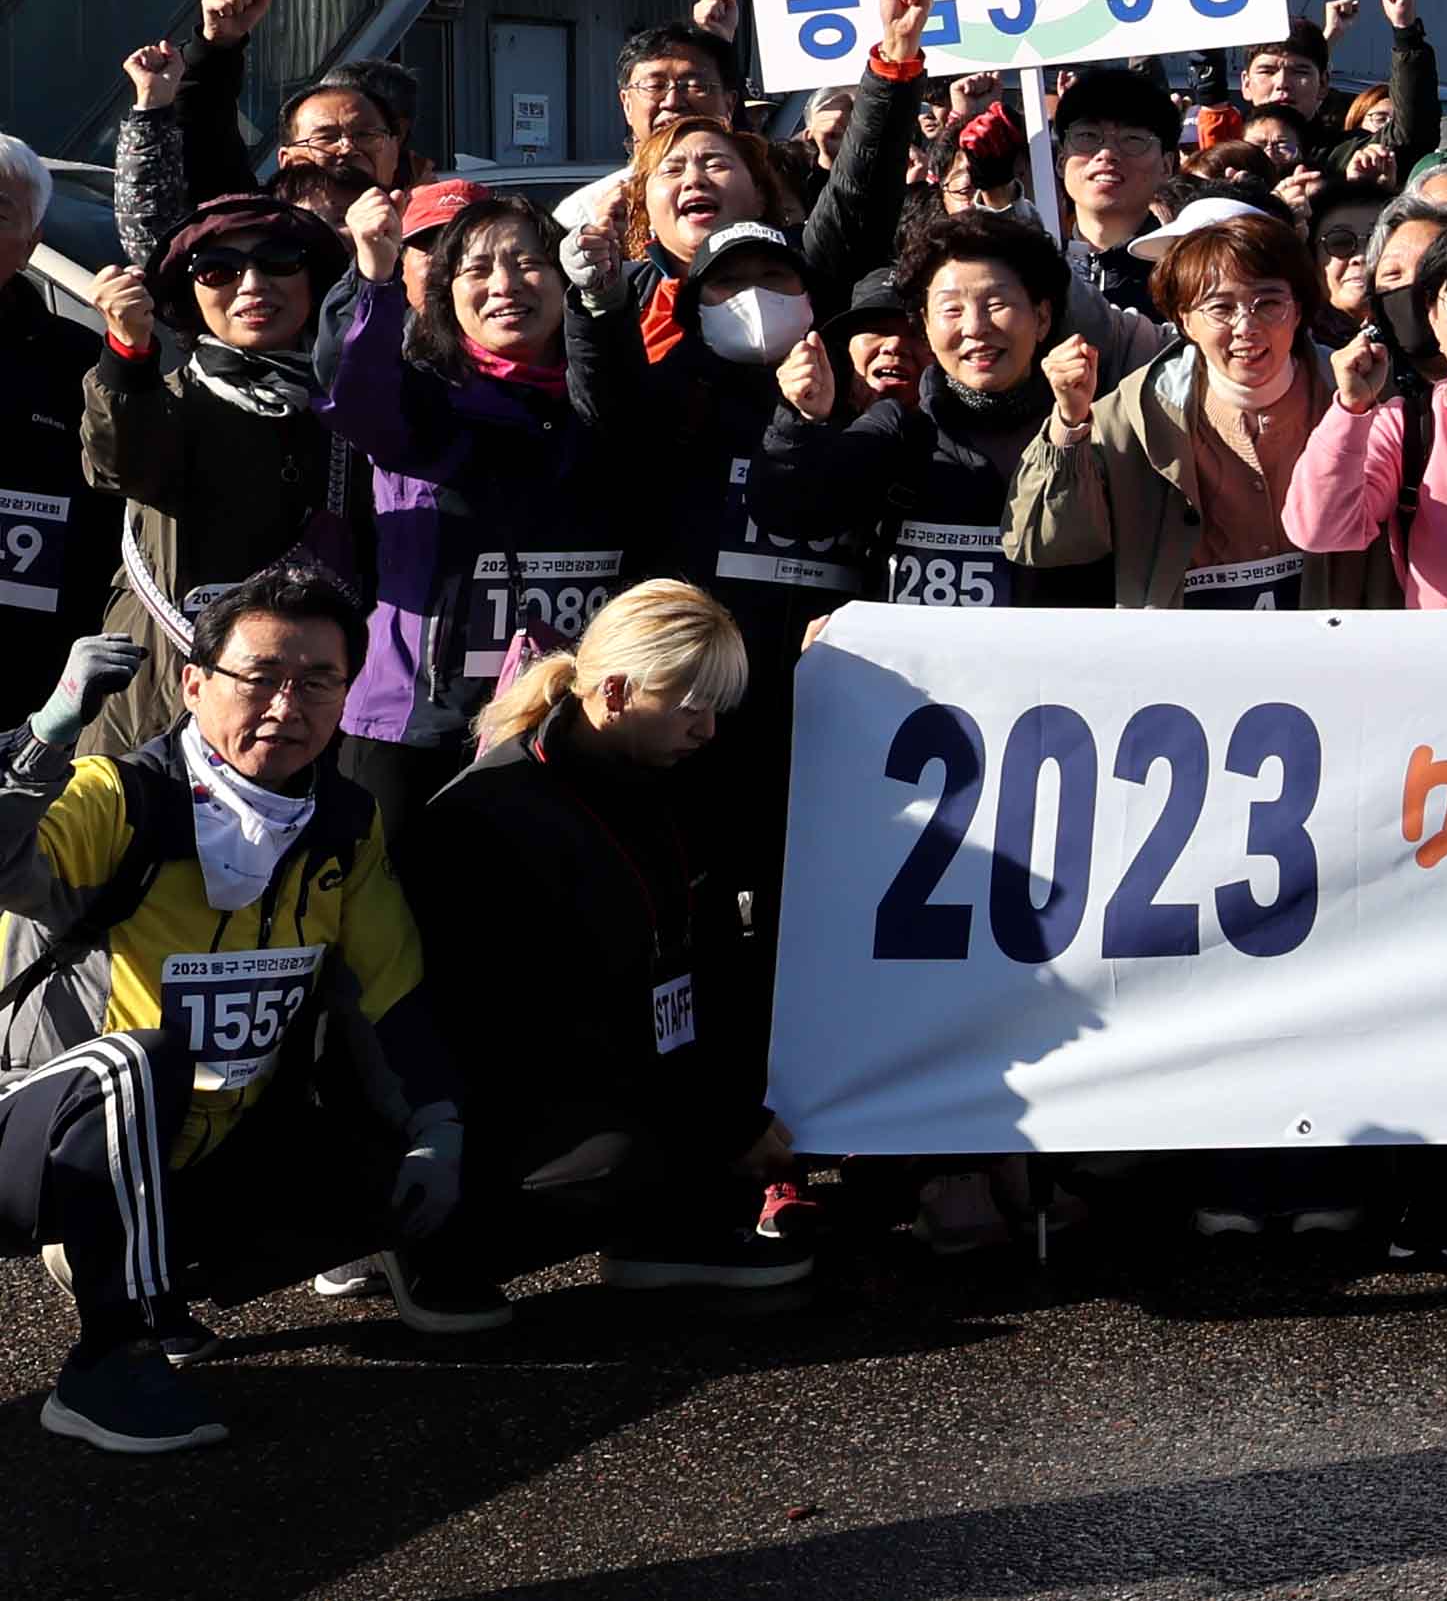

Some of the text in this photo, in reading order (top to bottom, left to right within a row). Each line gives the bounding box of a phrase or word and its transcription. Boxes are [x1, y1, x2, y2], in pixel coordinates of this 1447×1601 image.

[871, 700, 1323, 965] 2023
[171, 962, 208, 976] 2023
[655, 985, 693, 1041] STAFF
